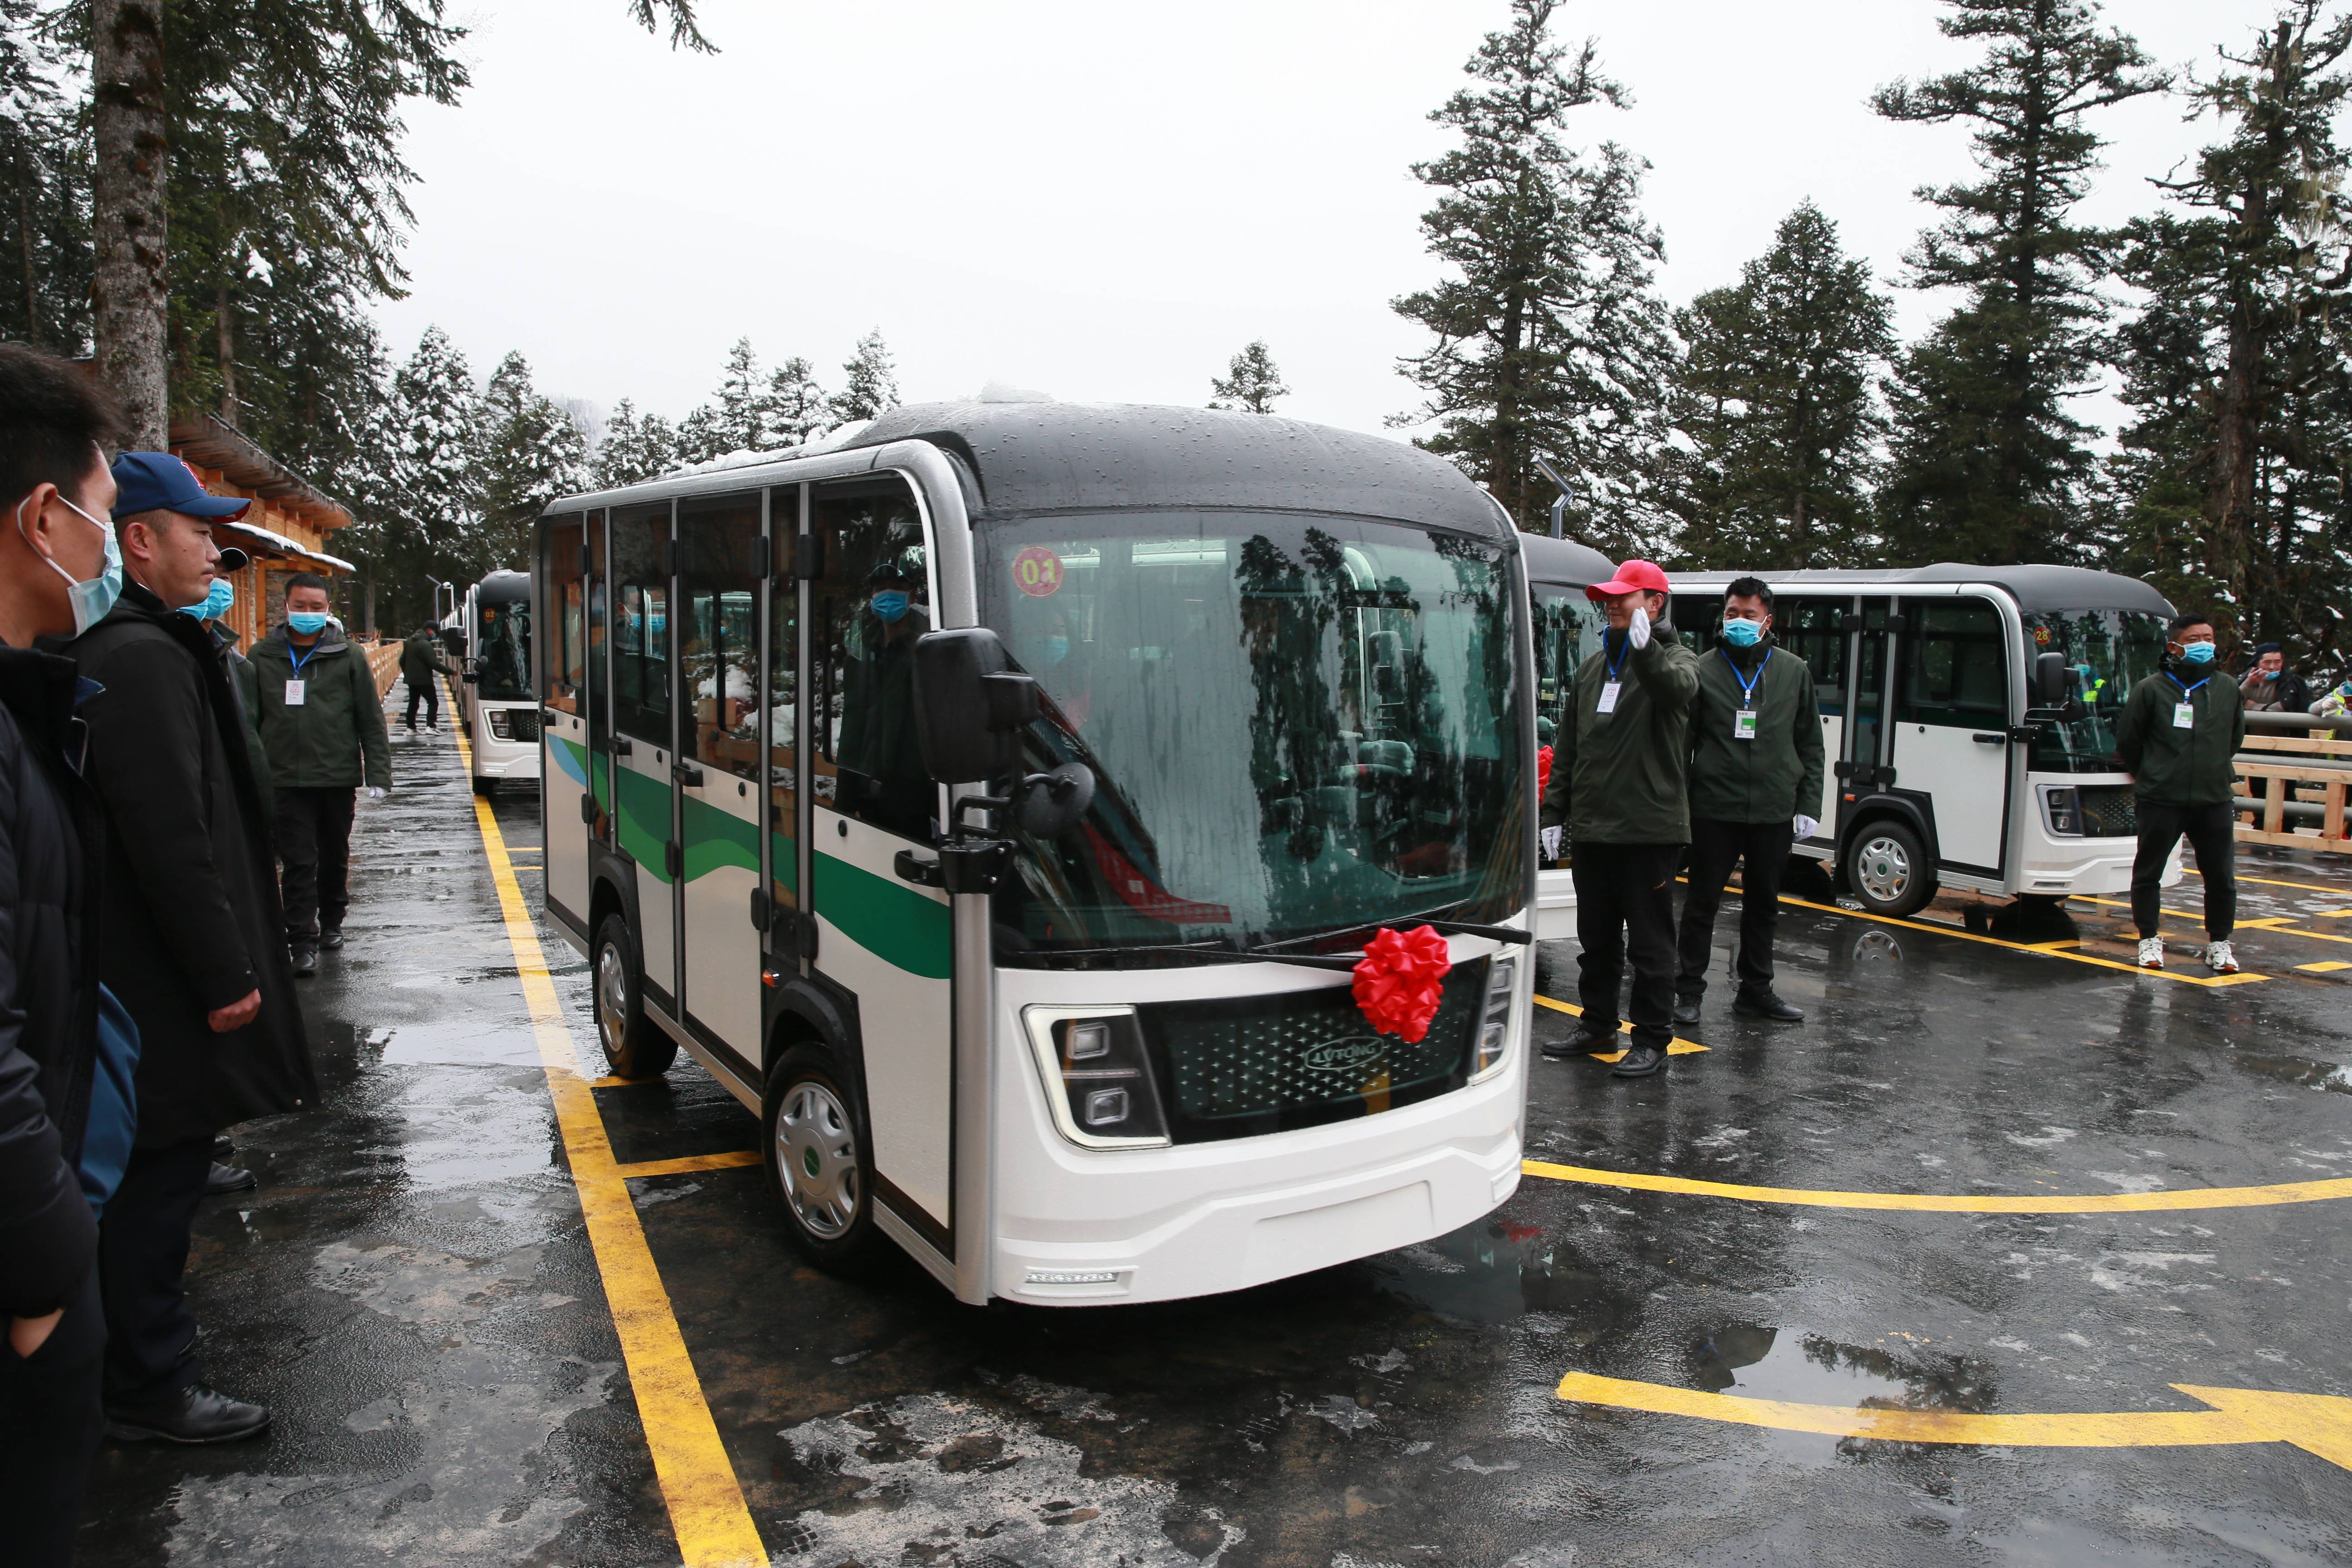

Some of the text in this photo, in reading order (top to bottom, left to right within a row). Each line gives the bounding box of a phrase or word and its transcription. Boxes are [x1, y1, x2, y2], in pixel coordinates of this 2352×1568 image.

[1021, 559, 1057, 585] 01
[2036, 631, 2048, 640] 28
[1315, 1044, 1377, 1063] LVTONG
